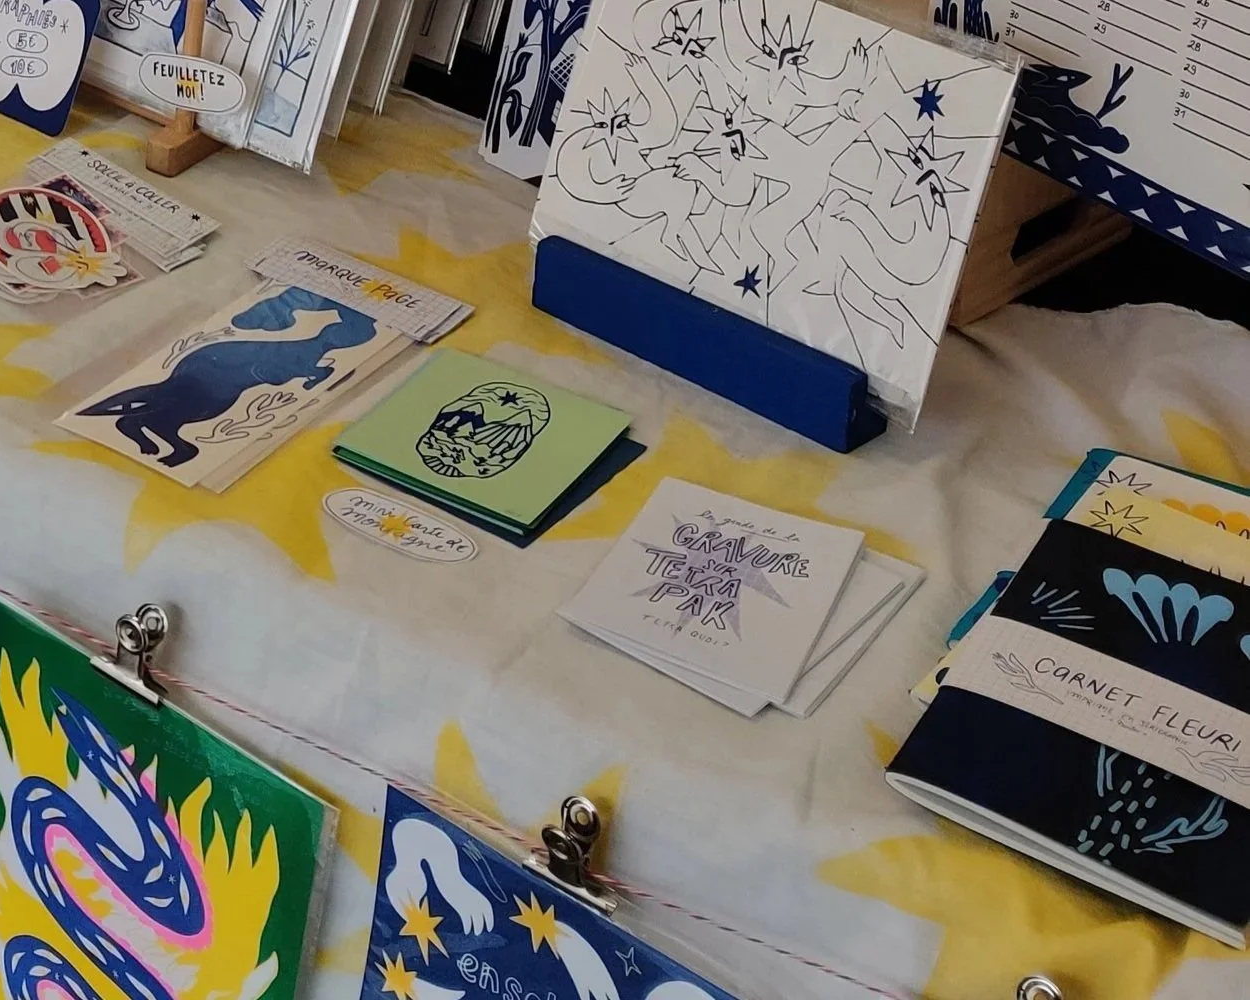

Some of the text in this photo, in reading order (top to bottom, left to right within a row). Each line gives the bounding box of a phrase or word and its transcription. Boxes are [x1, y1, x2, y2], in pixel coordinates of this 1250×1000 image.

[1009, 9, 1020, 20] 30
[1097, 0, 1111, 12] 28
[1004, 26, 1016, 38] 31
[1093, 22, 1107, 35] 29
[16, 32, 37, 50] 5€
[10, 60, 36, 75] 10€
[153, 61, 225, 86] FEUILLETEZ
[672, 523, 810, 579] GRAVURE
[645, 548, 742, 599] TETRA
[703, 559, 738, 578] SUR
[649, 582, 735, 631] PAK
[1152, 704, 1242, 752] FLEURI
